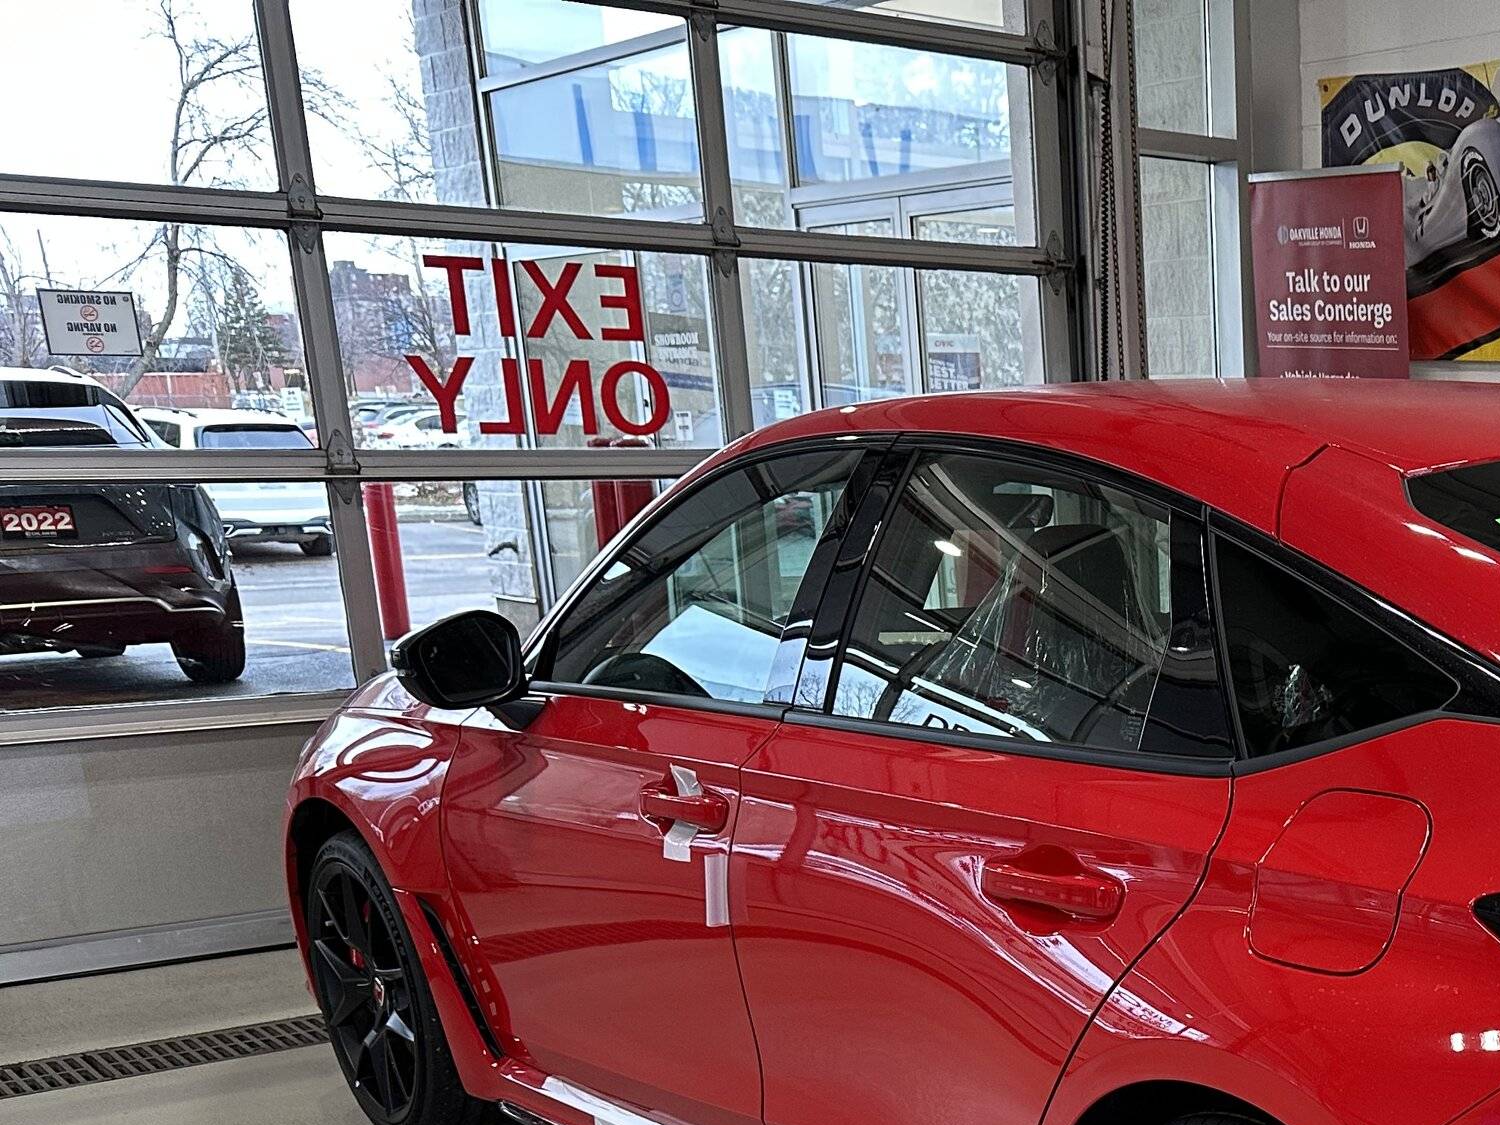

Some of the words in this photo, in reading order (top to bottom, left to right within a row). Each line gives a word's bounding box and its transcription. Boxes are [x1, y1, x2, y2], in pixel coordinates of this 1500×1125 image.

[1339, 82, 1476, 148] DUNLOP
[1289, 227, 1319, 241] OAKVILLE
[1319, 226, 1342, 240] HONDA
[1349, 241, 1376, 249] HONDA
[1285, 268, 1319, 293] Talk
[1322, 271, 1341, 293] to
[1343, 273, 1371, 293] our
[1269, 297, 1311, 322] Sales
[1314, 297, 1393, 329] Concierge
[1267, 332, 1283, 343] Your
[1283, 332, 1308, 343] on-site
[1309, 333, 1333, 344] source
[1333, 331, 1344, 344] for
[1344, 331, 1385, 344] information
[3, 512, 75, 531] 2022
